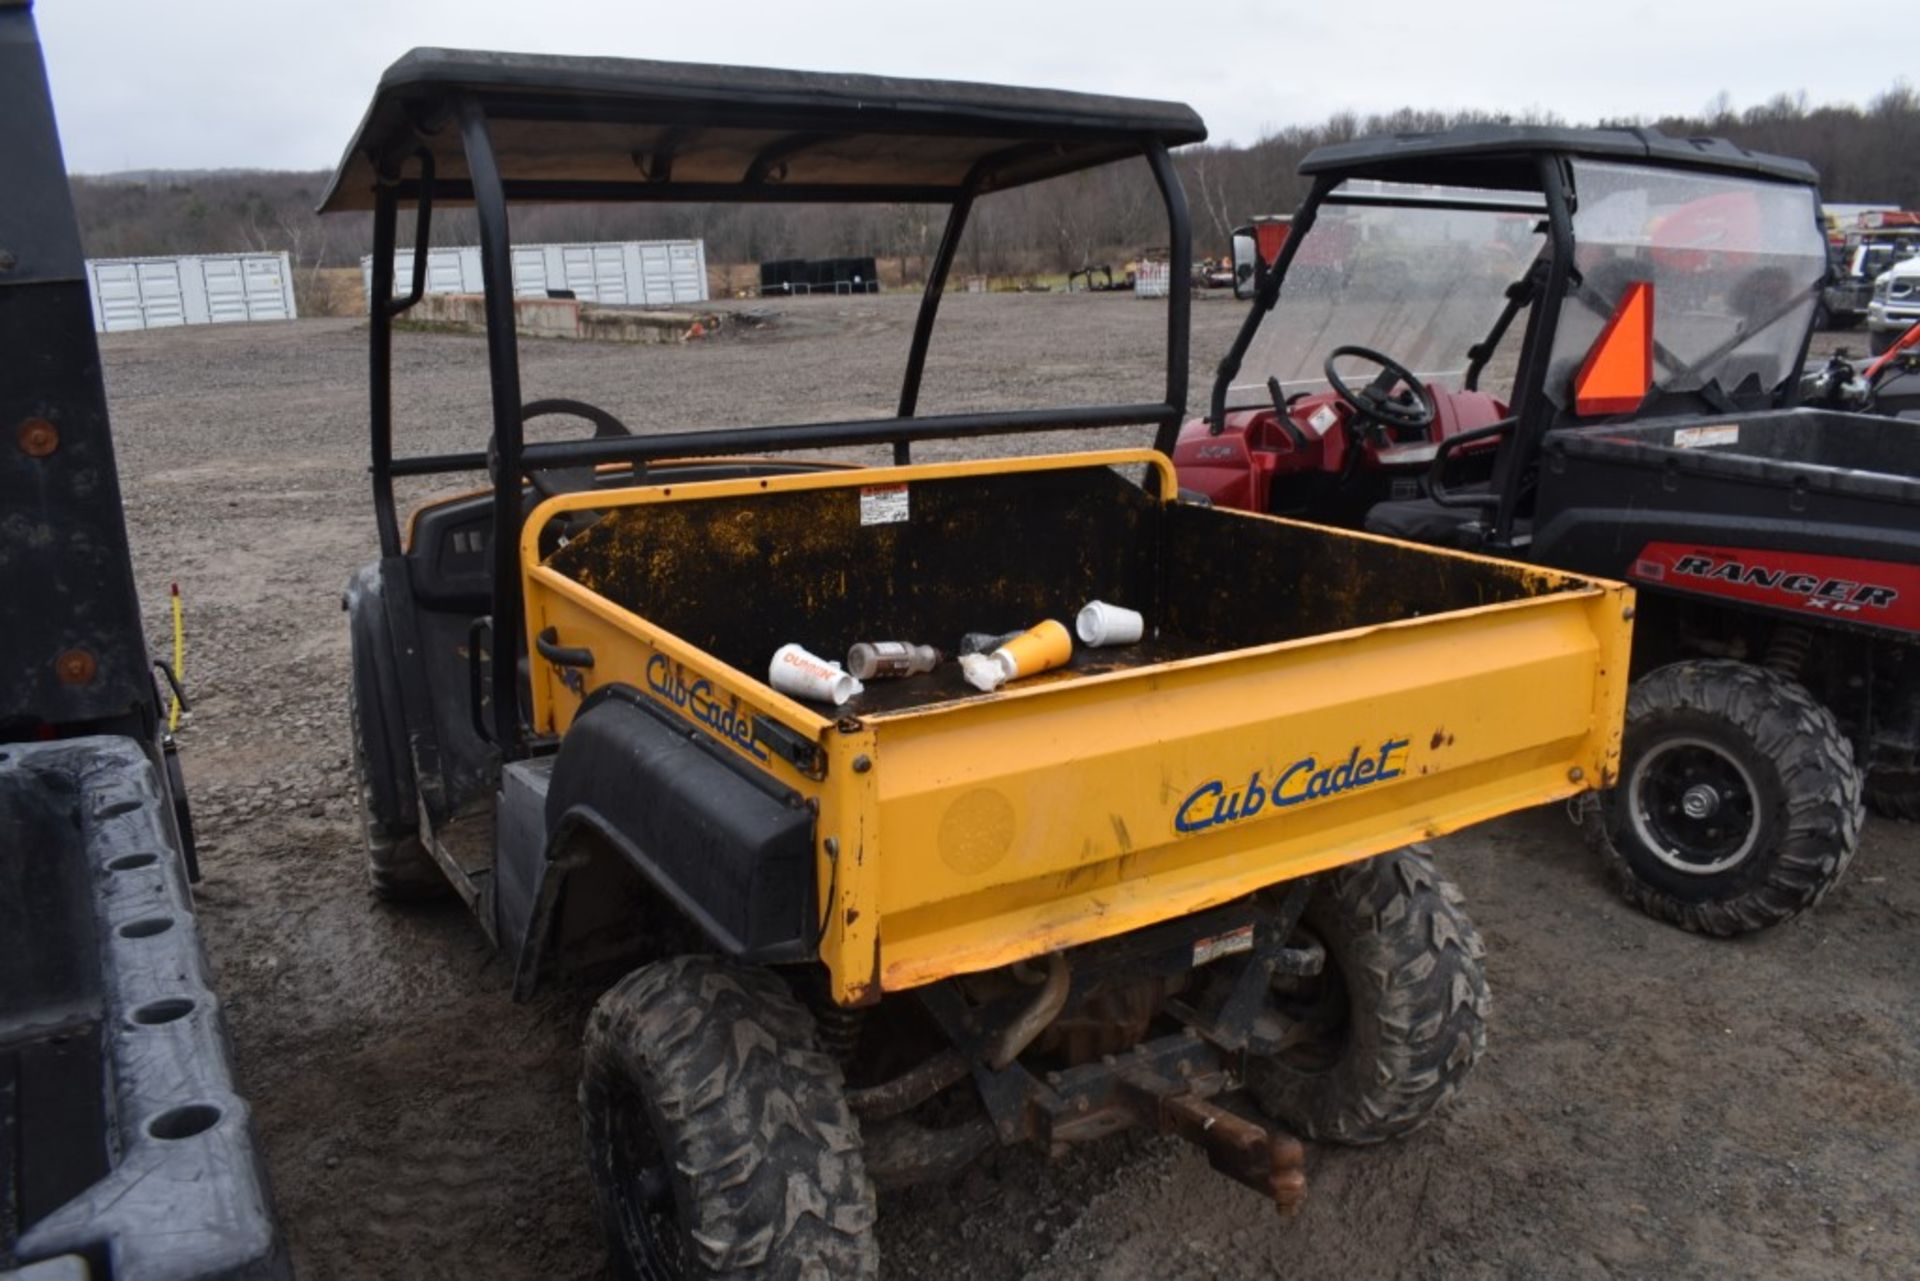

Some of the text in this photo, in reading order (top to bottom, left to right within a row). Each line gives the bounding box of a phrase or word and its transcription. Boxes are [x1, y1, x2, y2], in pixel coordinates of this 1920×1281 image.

[1672, 555, 1898, 608] RANGER
[1805, 598, 1860, 611] XP
[646, 654, 686, 707] Cub
[1175, 739, 1409, 833] Cub Cadet
